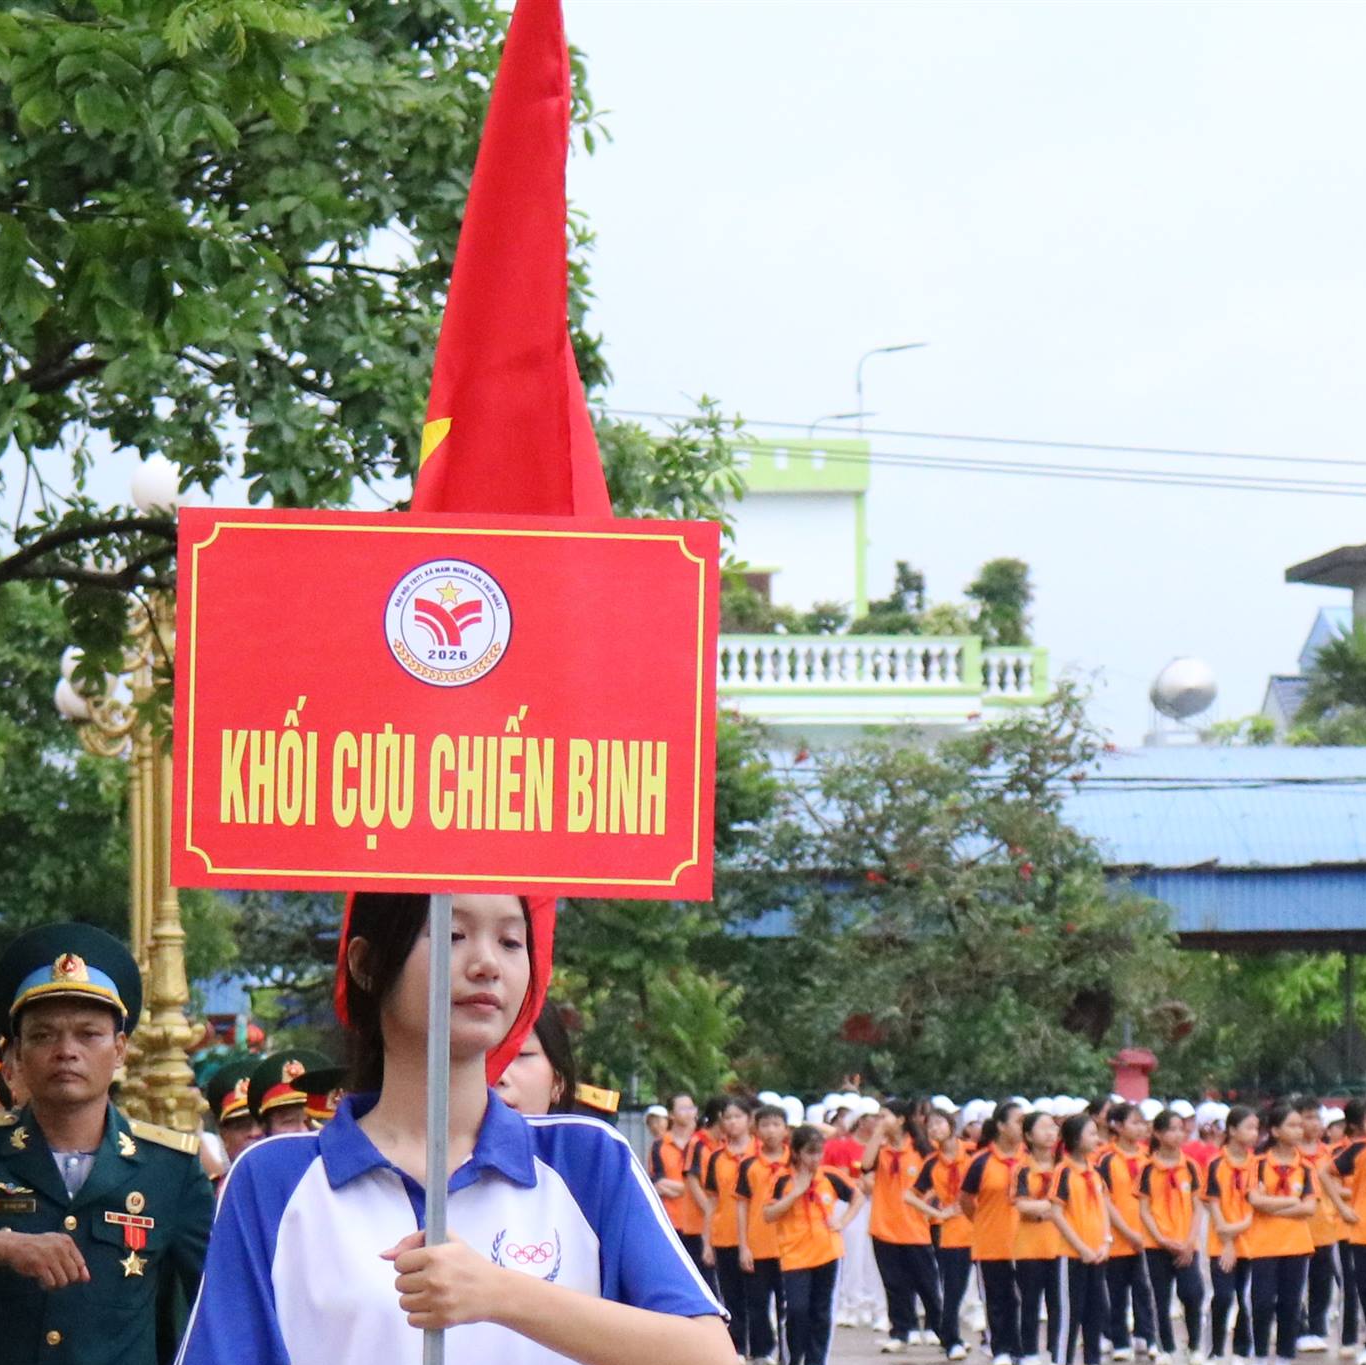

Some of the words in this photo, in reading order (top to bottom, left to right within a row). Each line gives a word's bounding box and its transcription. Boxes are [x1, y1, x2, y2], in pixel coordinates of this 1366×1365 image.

[428, 649, 468, 661] 2026
[220, 695, 318, 826] KHỐI
[332, 723, 416, 850] CỰU
[429, 705, 555, 833] CHIẾN
[567, 738, 668, 836] BINH
